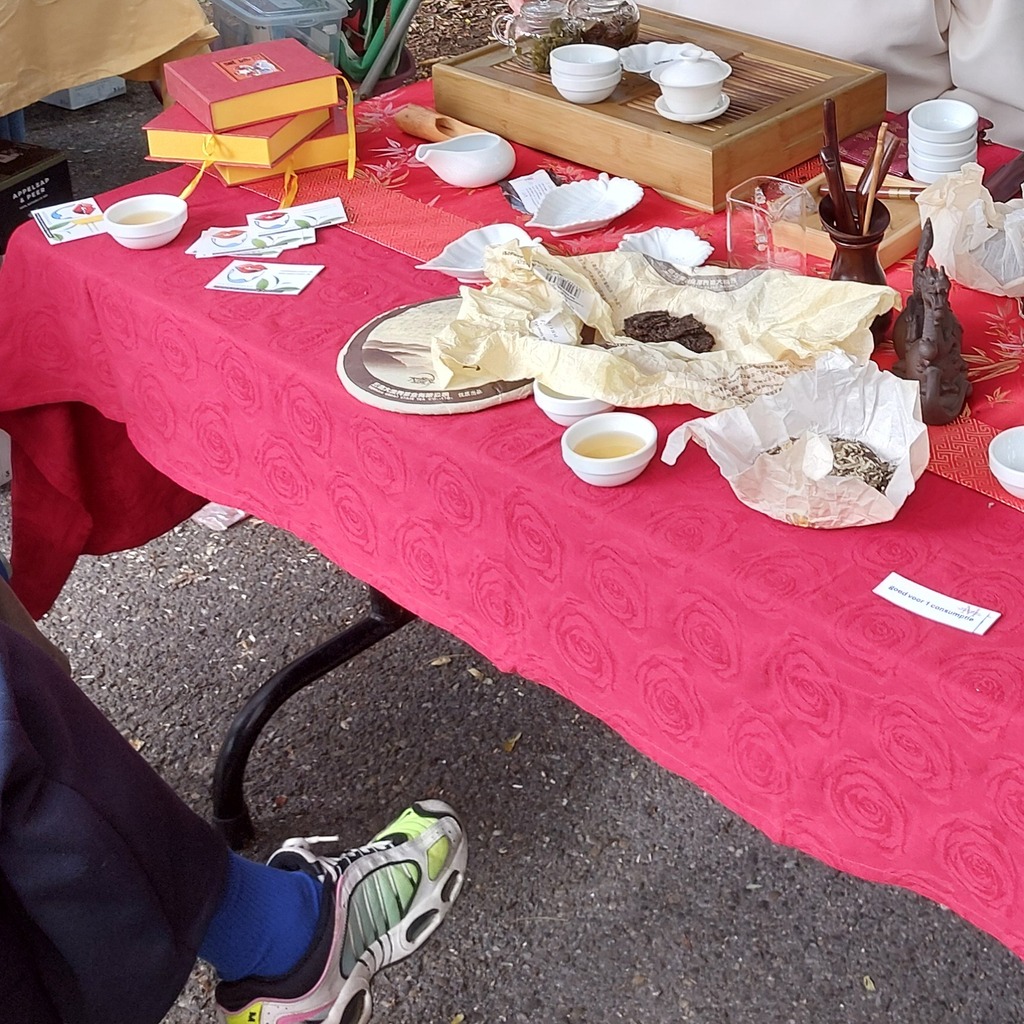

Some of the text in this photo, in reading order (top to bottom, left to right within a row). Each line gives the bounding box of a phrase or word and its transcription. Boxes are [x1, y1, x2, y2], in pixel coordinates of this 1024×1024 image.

[12, 177, 50, 200] APPELSAP
[26, 187, 46, 200] PEER
[888, 585, 909, 596] goed
[908, 594, 925, 604] voor
[930, 603, 975, 622] consumptie
